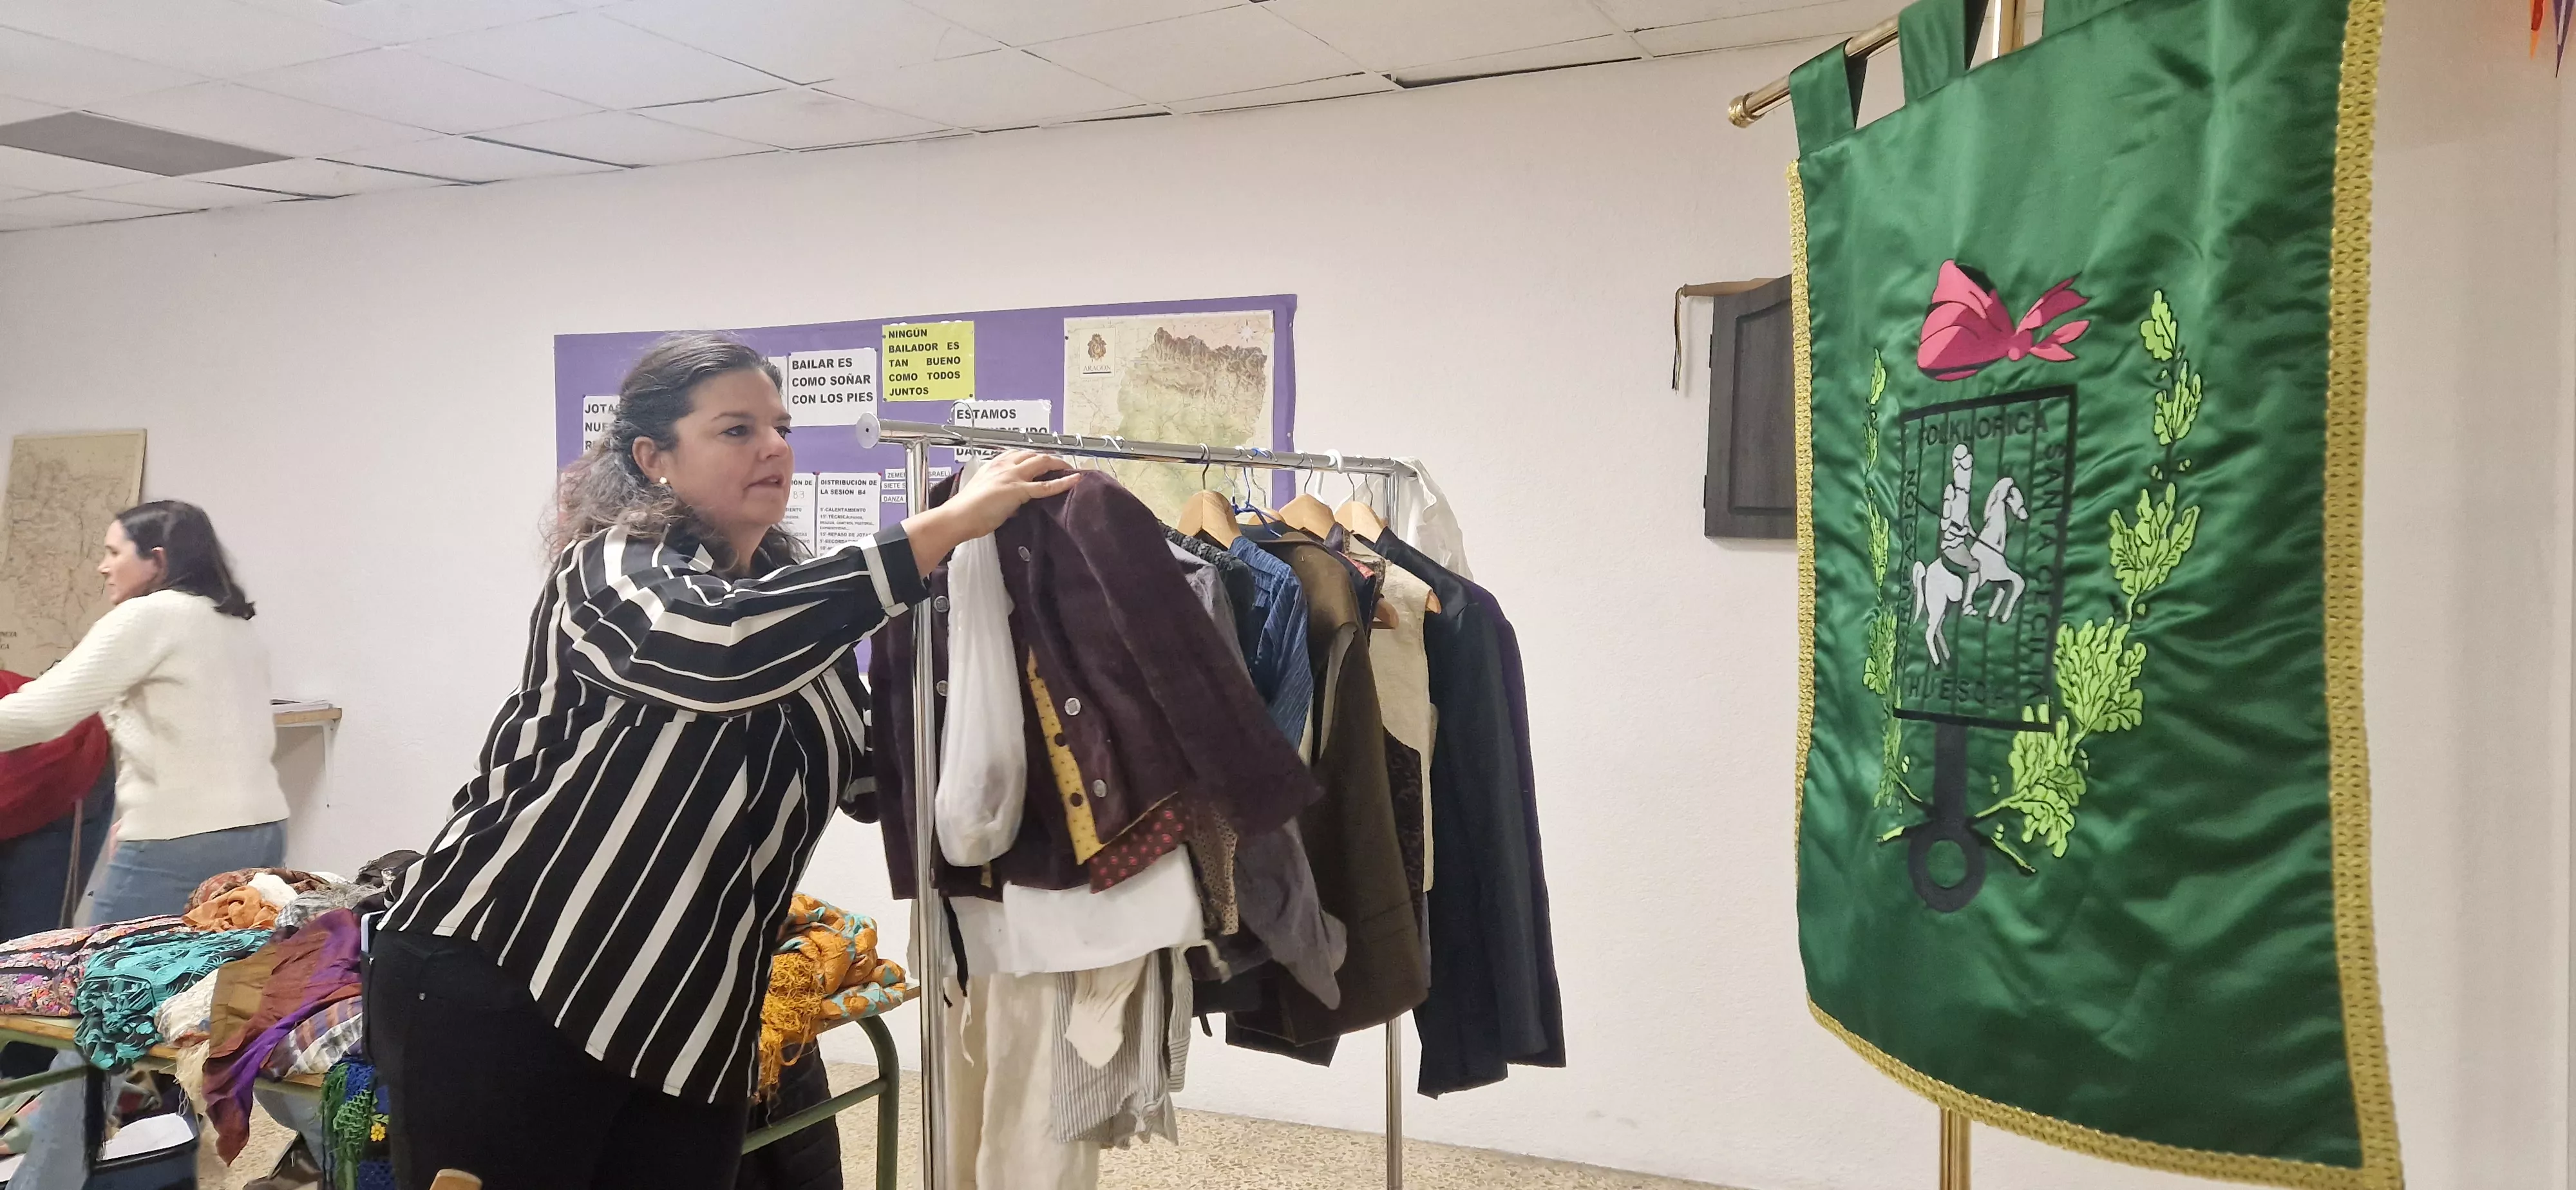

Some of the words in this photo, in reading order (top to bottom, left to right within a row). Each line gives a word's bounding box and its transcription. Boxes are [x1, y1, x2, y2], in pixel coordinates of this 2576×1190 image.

[889, 327, 927, 339] NINGÚN
[889, 343, 938, 353] BAILADOR
[947, 341, 960, 350] ES
[792, 358, 834, 370] BAILAR
[838, 357, 853, 368] ES
[889, 359, 909, 367] TAN
[927, 356, 961, 366] BUENO
[792, 377, 826, 387] COMO
[830, 373, 871, 386] SOÑAR
[889, 373, 918, 382] COMO
[927, 371, 960, 380] TODOS
[889, 387, 929, 396] JUNTOS
[791, 394, 816, 404] CON
[820, 393, 843, 403] LOS
[847, 392, 873, 402] PIES
[956, 409, 1016, 419] ESTAMOS
